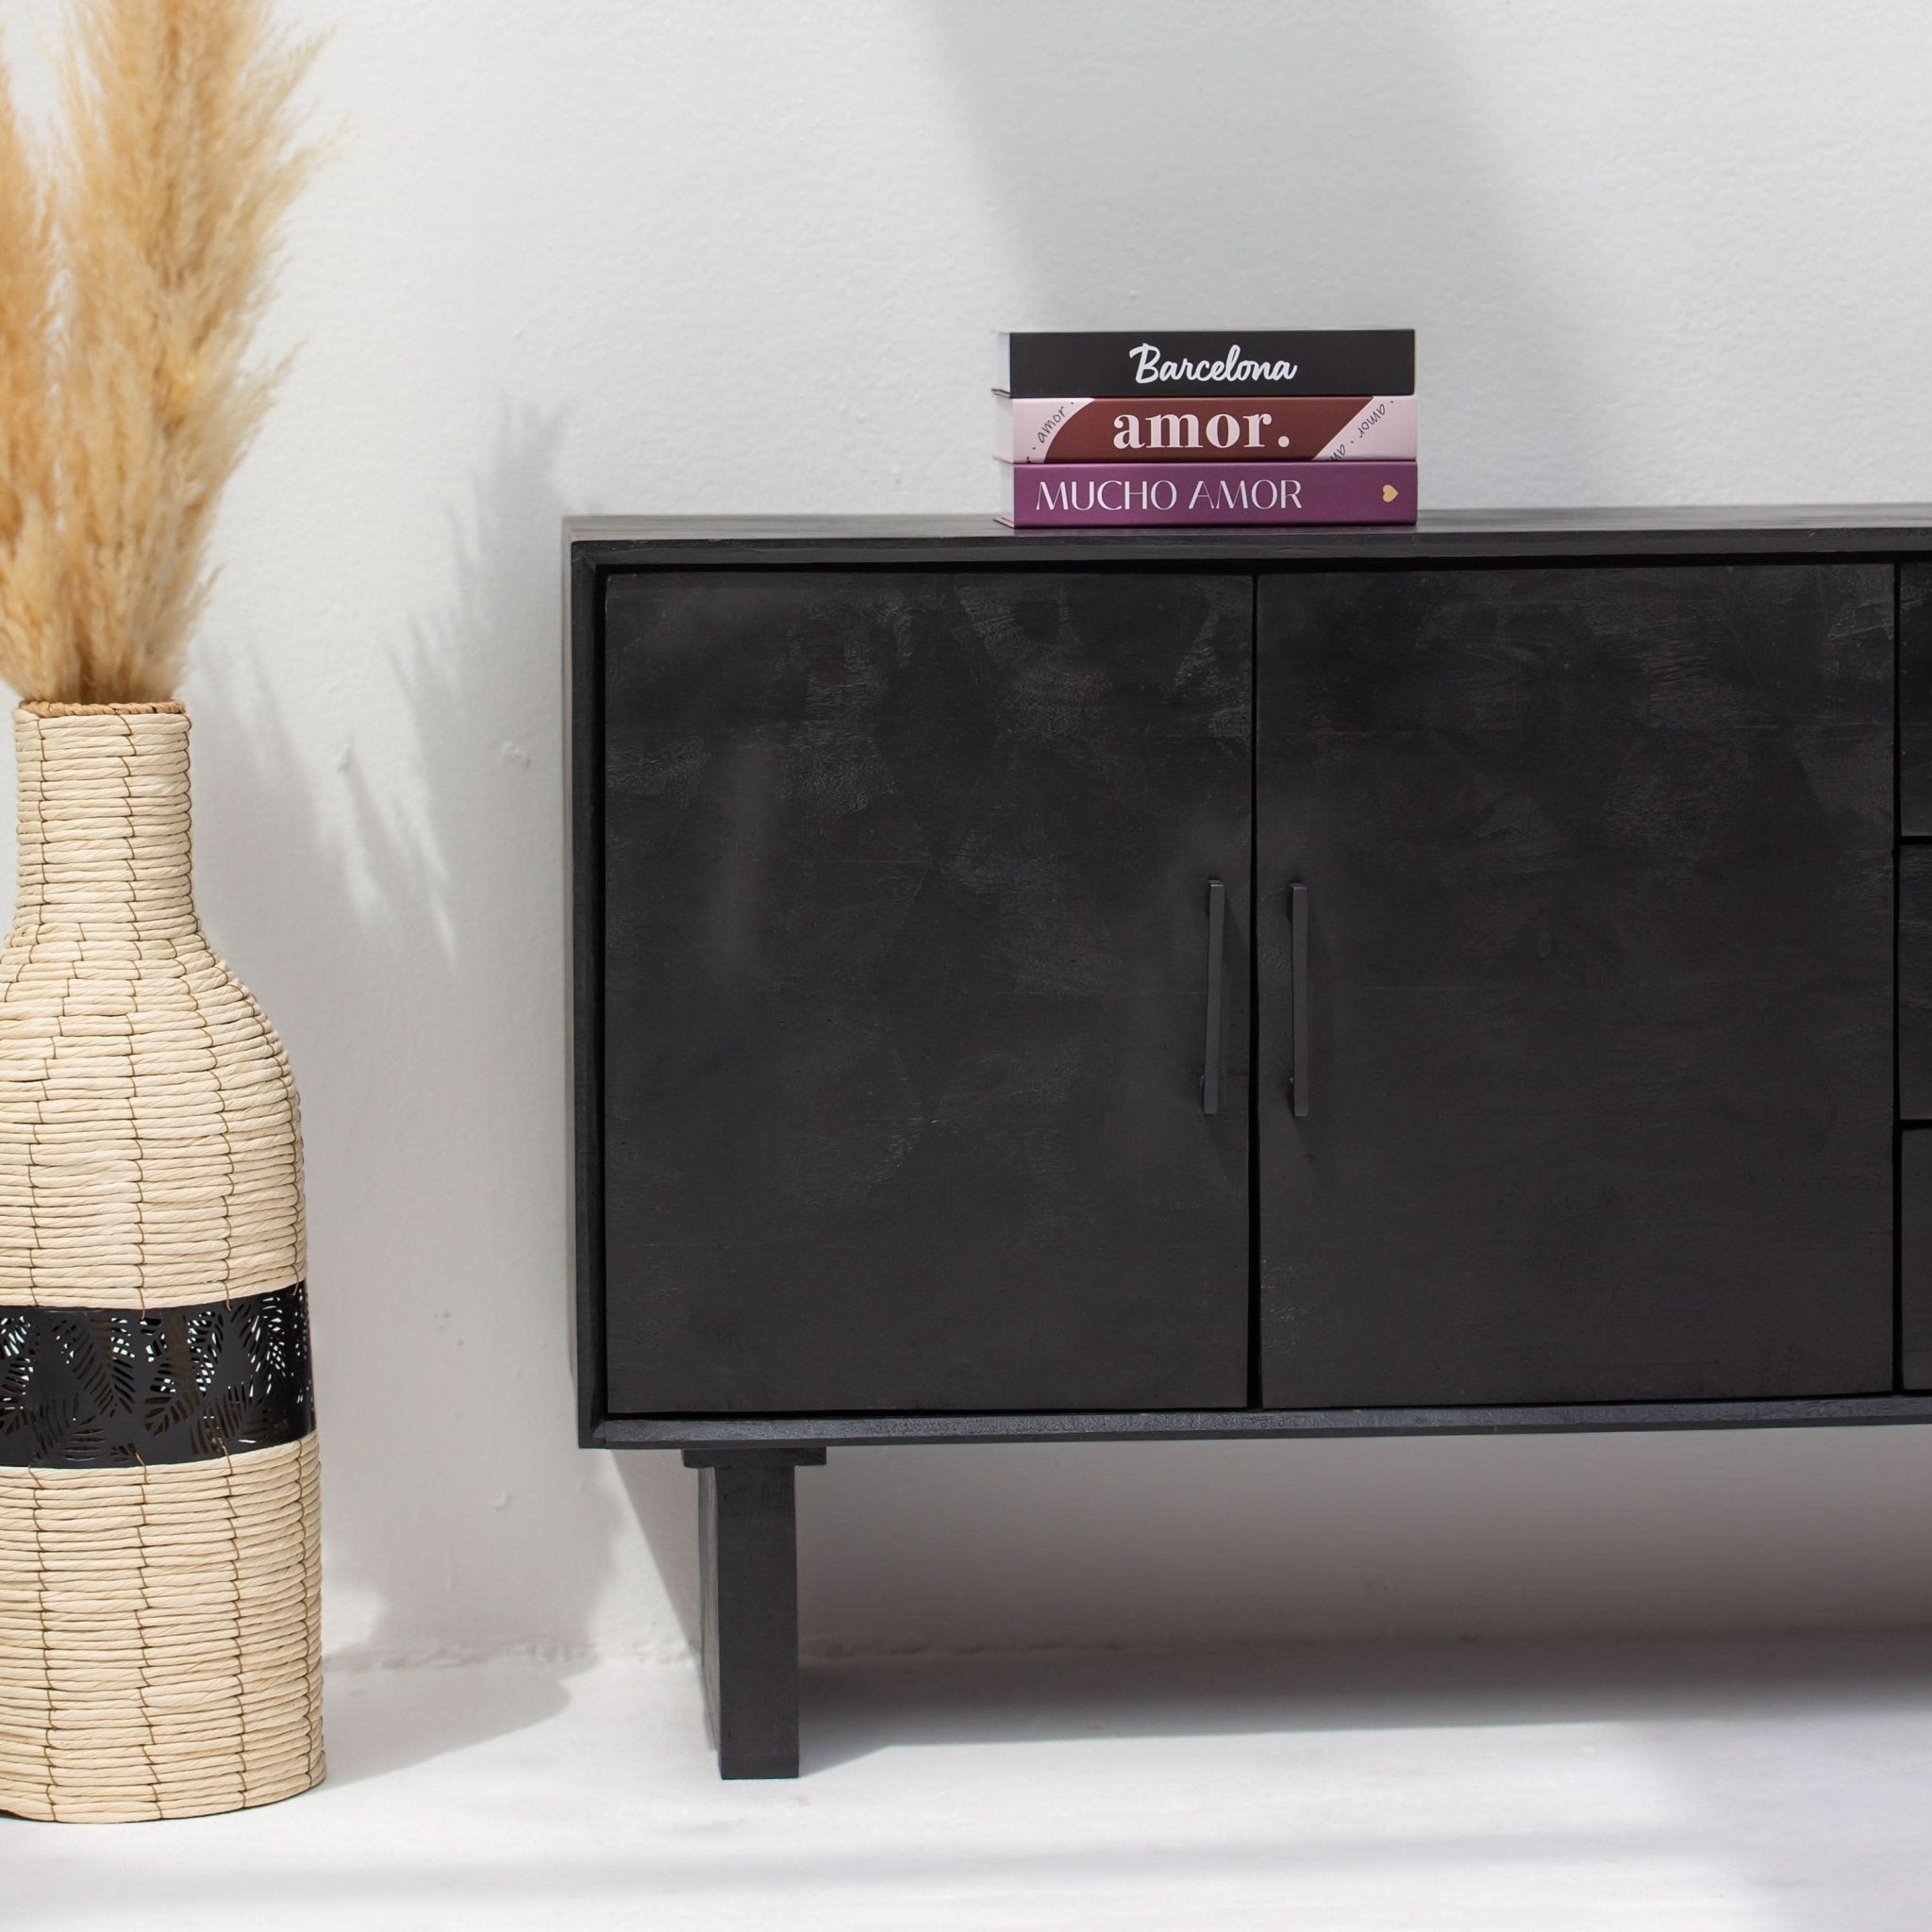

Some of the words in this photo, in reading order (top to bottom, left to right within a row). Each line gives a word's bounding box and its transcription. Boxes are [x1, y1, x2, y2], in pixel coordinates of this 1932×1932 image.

[1129, 343, 1298, 384] Barcelona
[1038, 406, 1065, 443] amor
[1113, 413, 1291, 449] amor.
[1357, 404, 1386, 438] amor
[1036, 479, 1177, 510] MUCHO
[1188, 479, 1303, 509] AMOR
